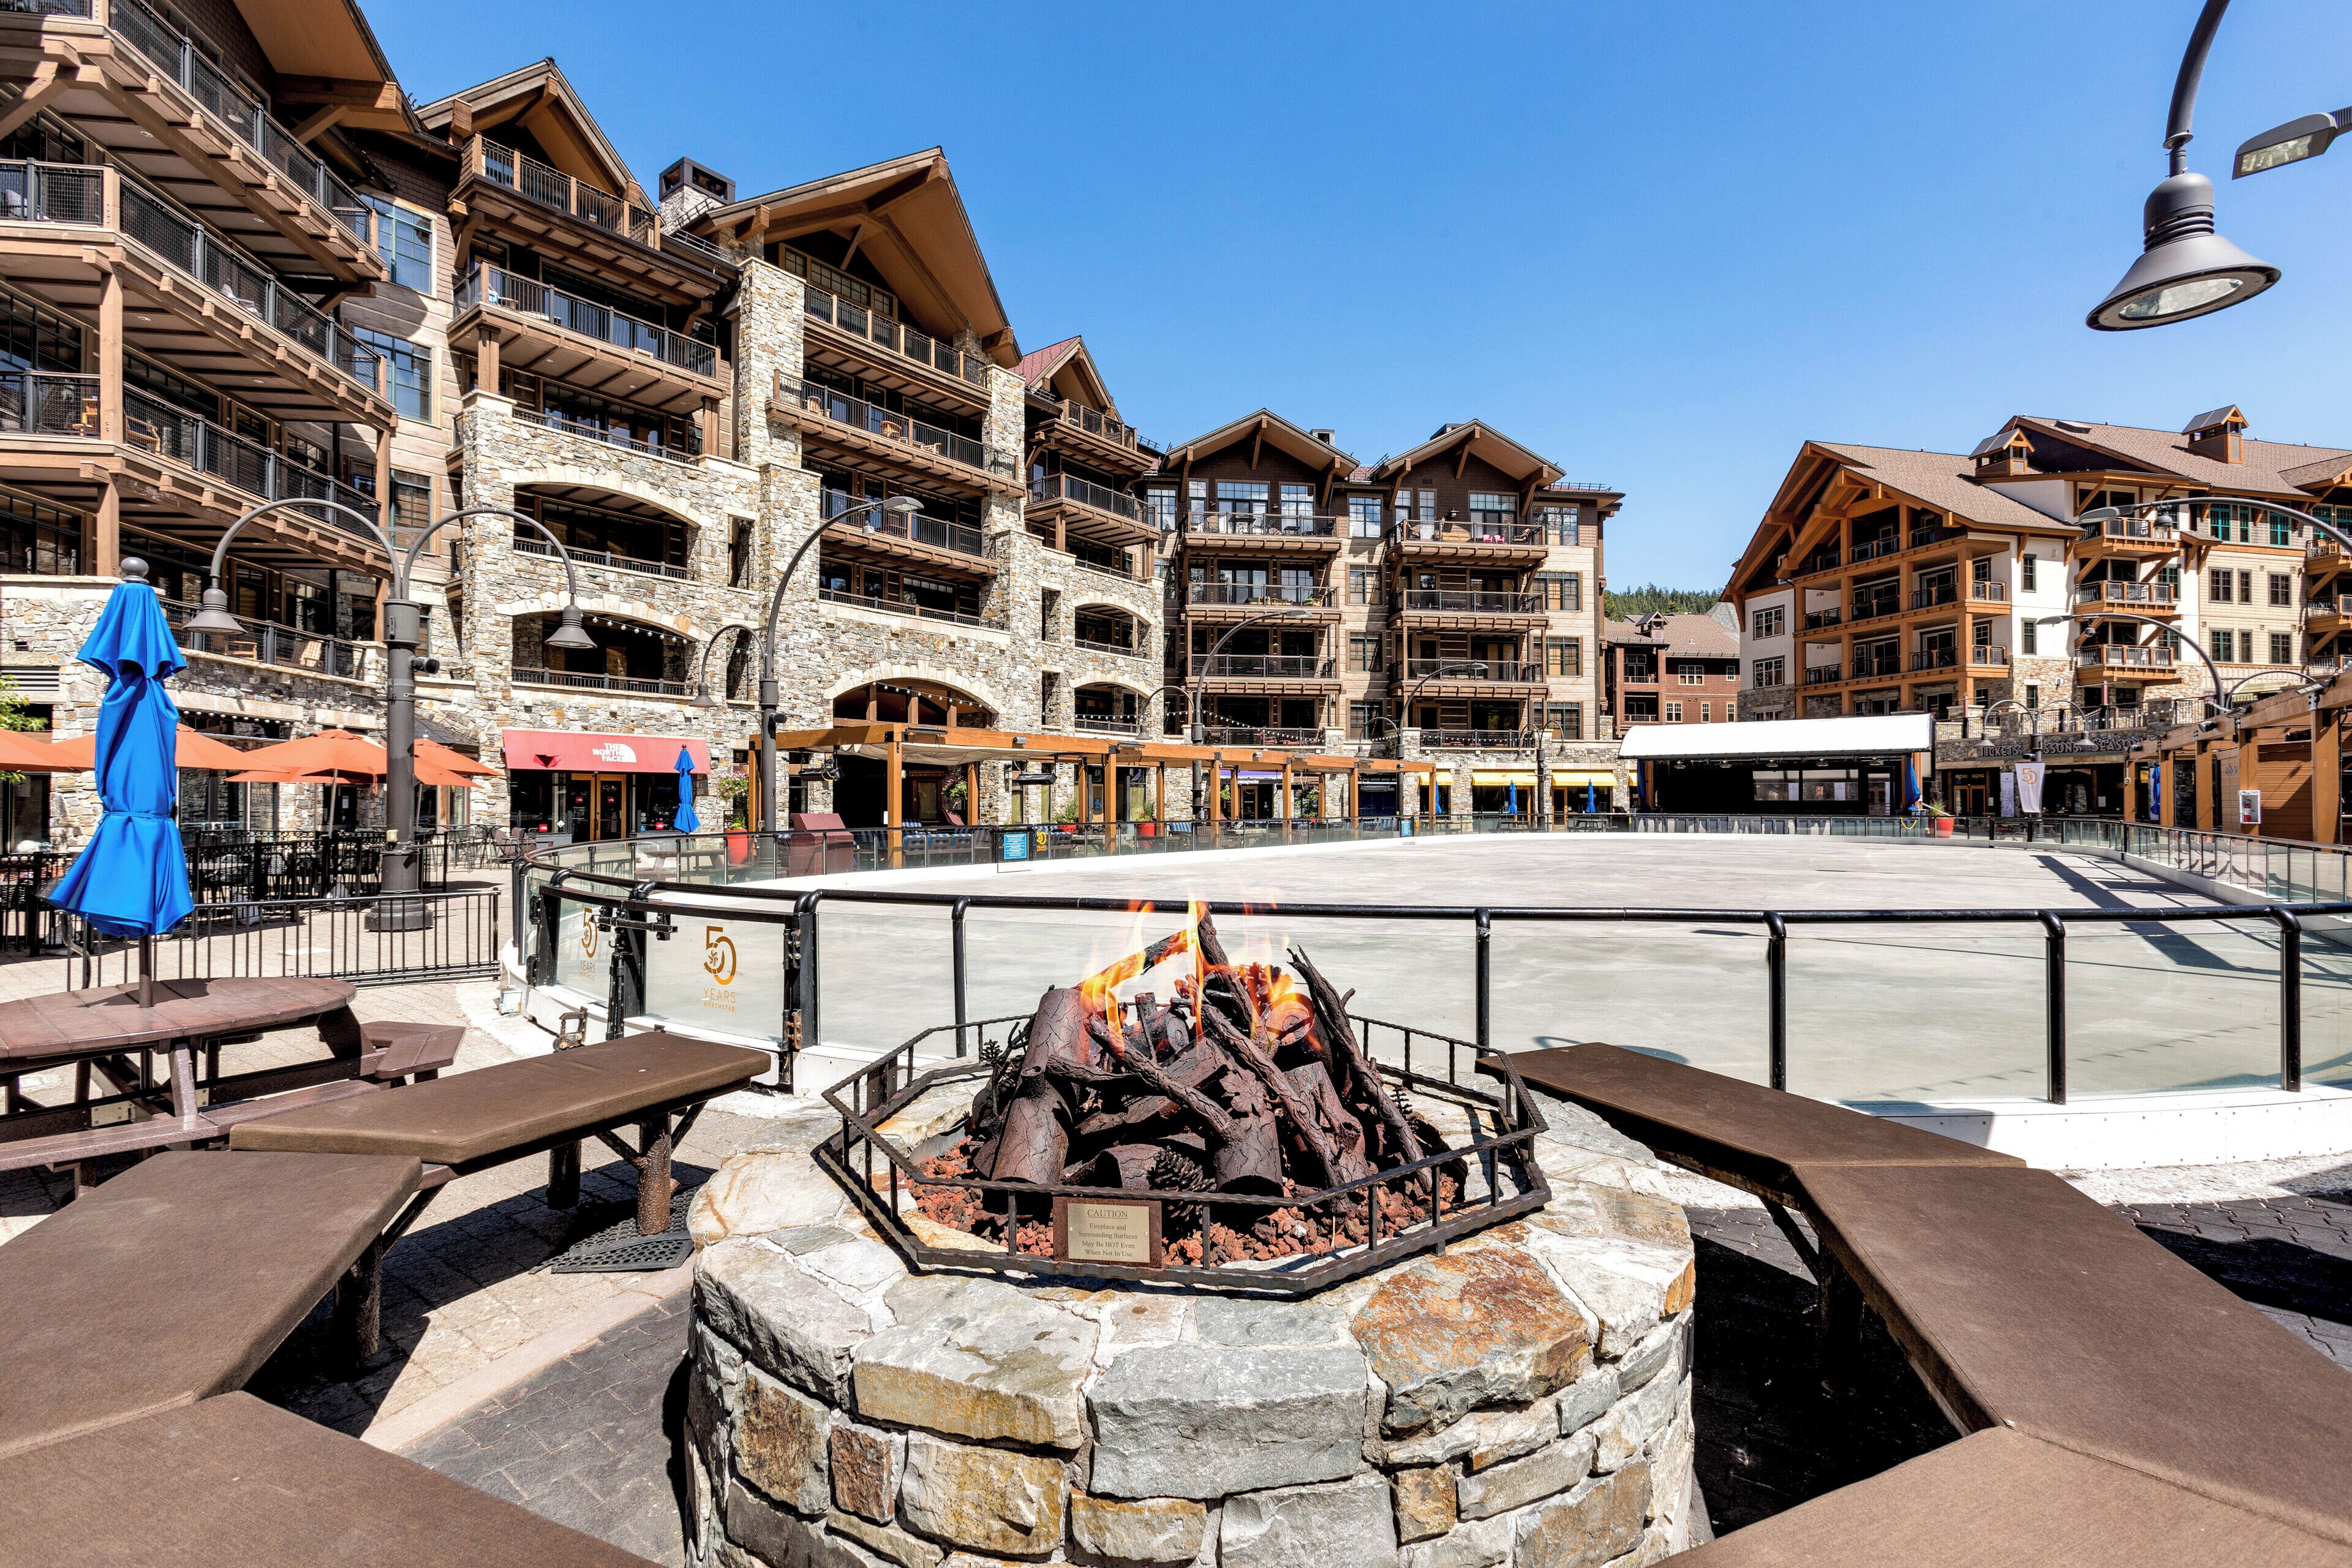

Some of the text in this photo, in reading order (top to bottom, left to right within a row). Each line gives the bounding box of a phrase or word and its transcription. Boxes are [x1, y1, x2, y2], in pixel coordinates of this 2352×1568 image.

[1979, 744, 2021, 757] TICKETS
[2022, 767, 2037, 785] 50
[704, 925, 737, 986] 50
[580, 960, 595, 973] YEARS
[703, 987, 736, 1003] YEARS
[703, 1001, 736, 1012] NORTHSTAR
[1087, 1209, 1128, 1218] CAUTION
[1079, 1231, 1112, 1240] Surrounding
